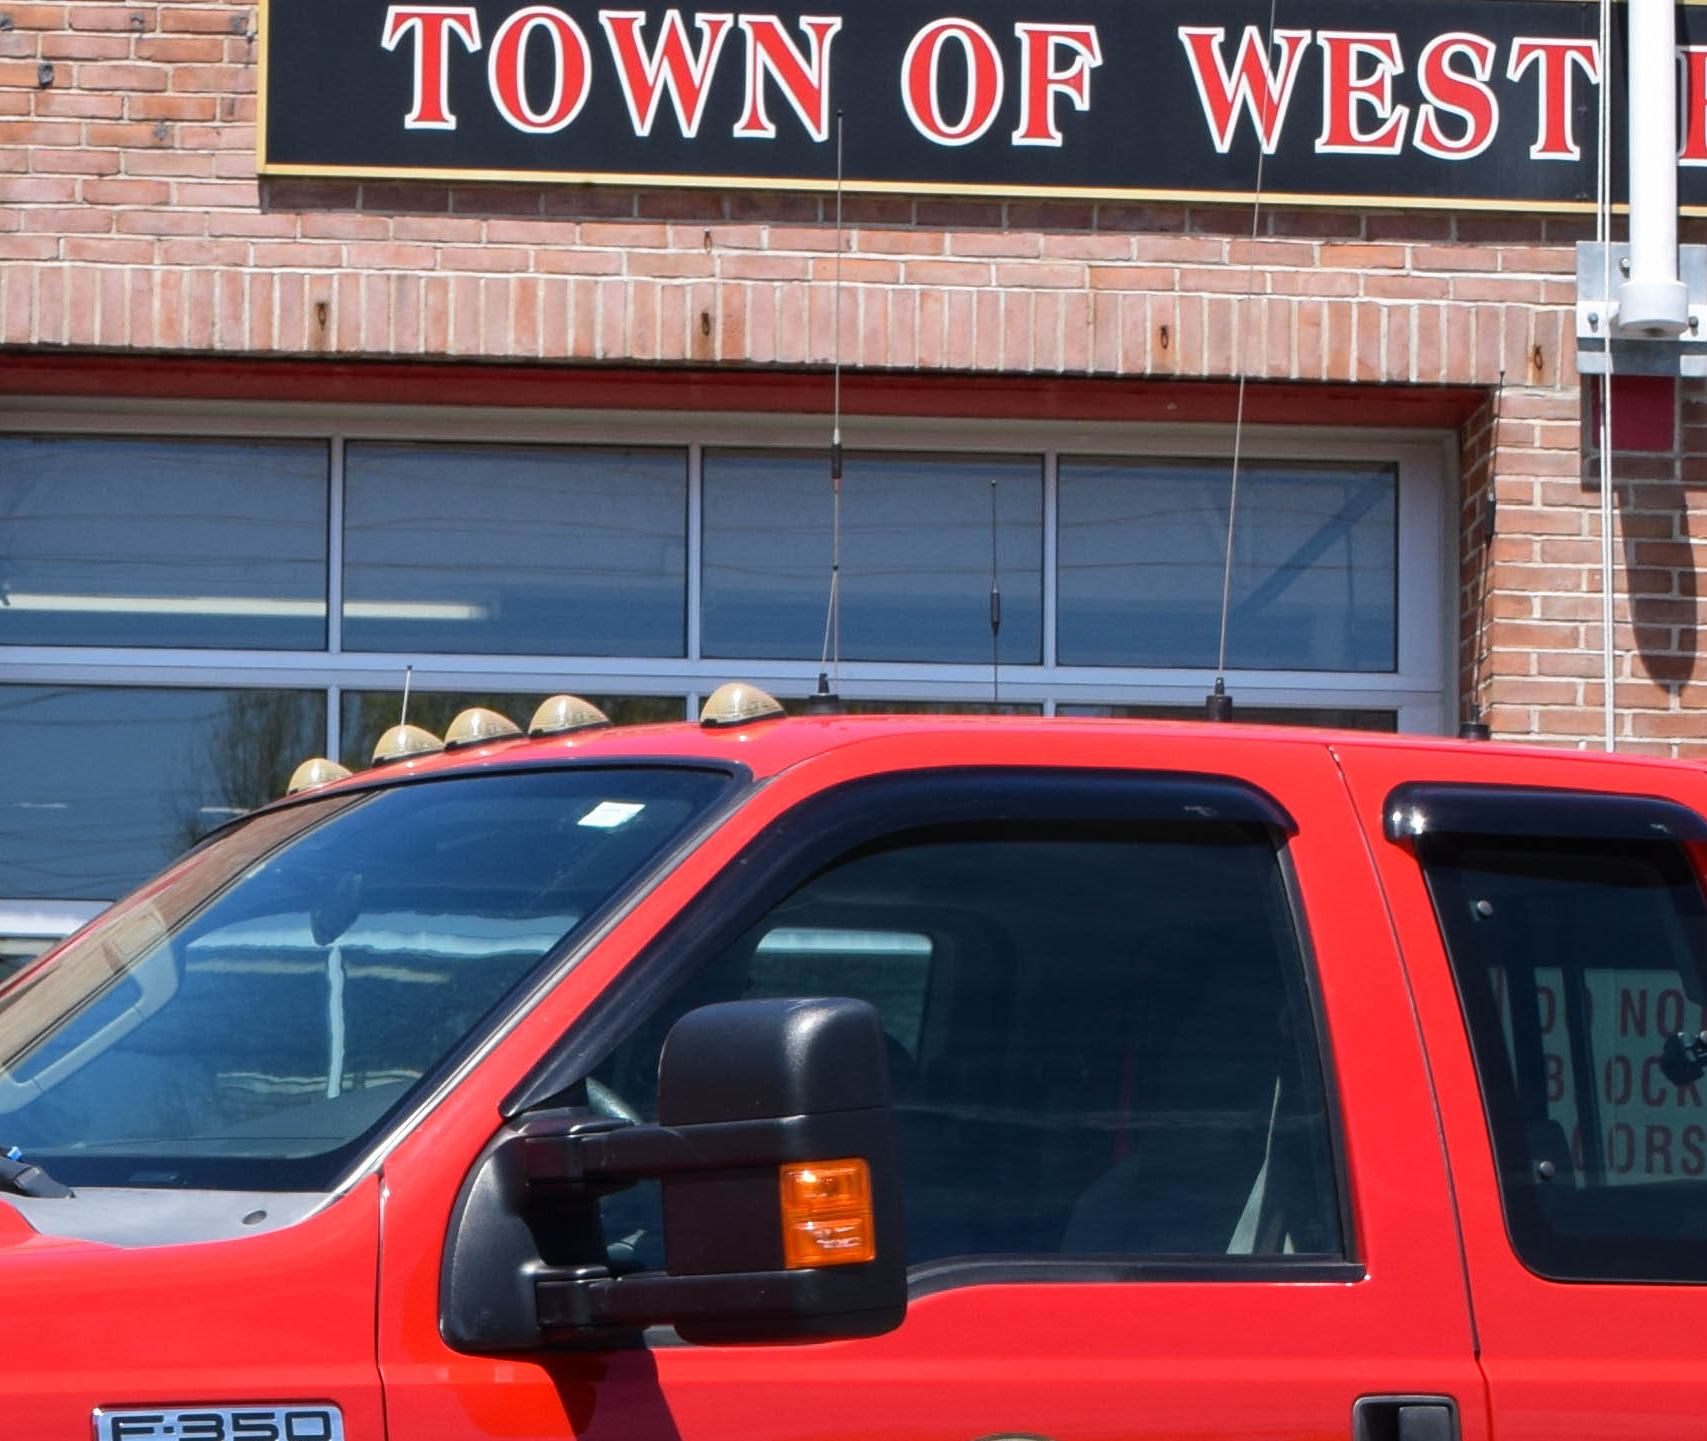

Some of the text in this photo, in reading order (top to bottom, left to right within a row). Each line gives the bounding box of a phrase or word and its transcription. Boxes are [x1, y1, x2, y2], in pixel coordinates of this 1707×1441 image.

[383, 4, 841, 142] TOWN
[900, 17, 1103, 148] OF
[1178, 23, 1600, 162] WEST
